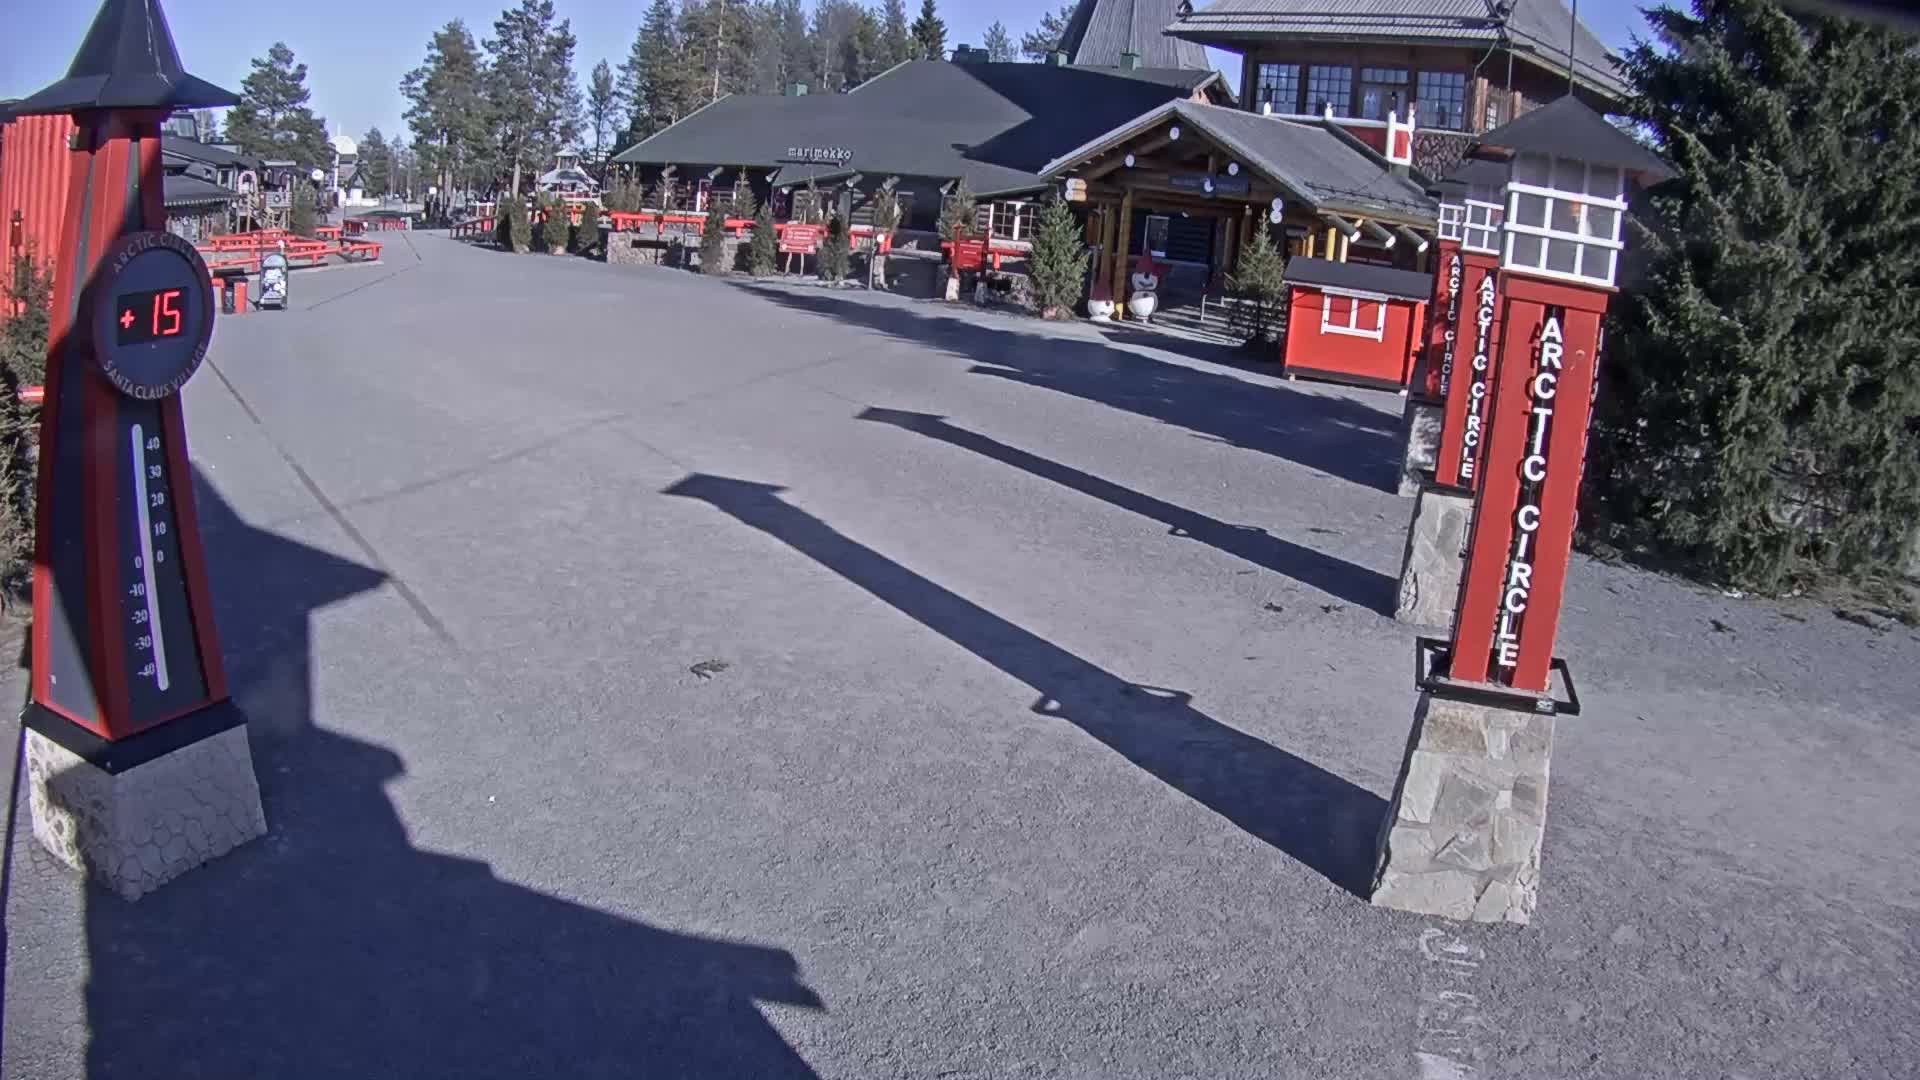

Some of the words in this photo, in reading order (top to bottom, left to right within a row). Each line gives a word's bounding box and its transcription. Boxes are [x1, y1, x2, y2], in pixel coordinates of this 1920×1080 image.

[788, 147, 852, 160] marimekko
[113, 233, 157, 273] ARCTIC
[1447, 255, 1460, 321] ARCTIC
[1472, 276, 1495, 371] ARCTIC
[1440, 330, 1455, 396] CIRCLE
[103, 359, 133, 396] SANTA
[134, 382, 169, 400] CLAUS
[1523, 317, 1562, 482] ARCTIC
[146, 436, 160, 450] 40
[1461, 382, 1485, 478] CIRCLE
[149, 465, 162, 479] 30
[152, 492, 165, 507] 20
[155, 521, 167, 536] 10
[135, 556, 142, 568] 0
[157, 549, 164, 562] 0
[129, 583, 145, 597] -10
[1498, 504, 1540, 667] CIRCLE
